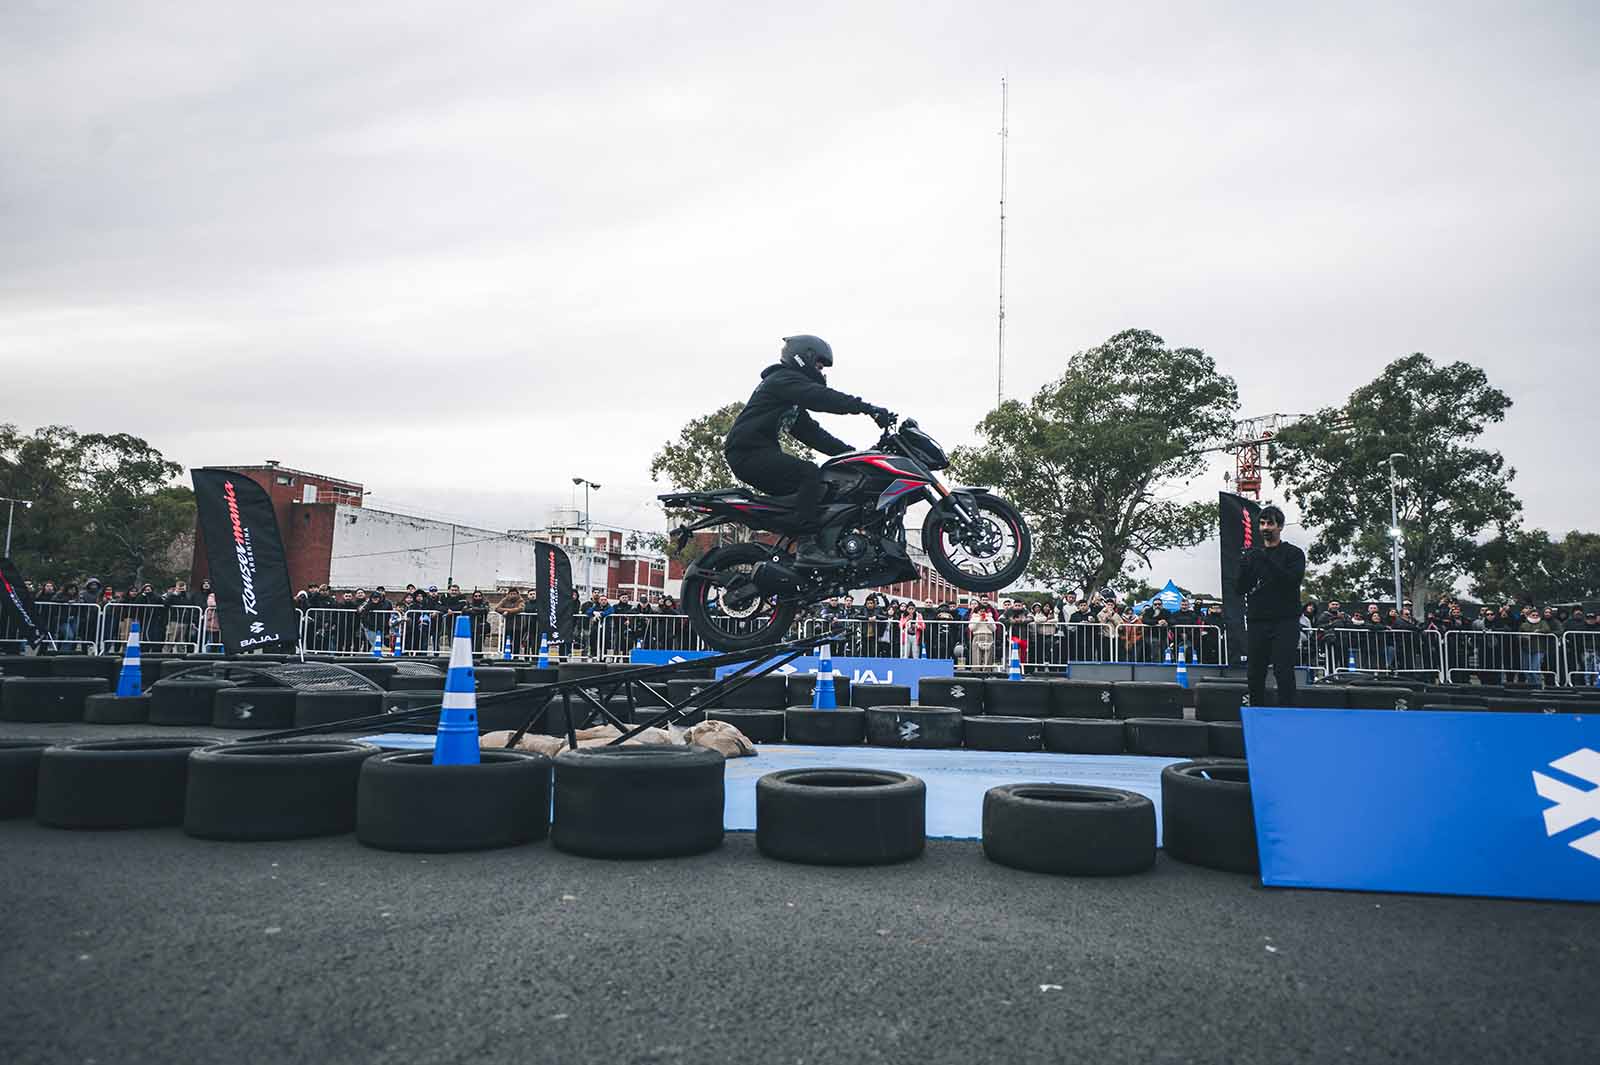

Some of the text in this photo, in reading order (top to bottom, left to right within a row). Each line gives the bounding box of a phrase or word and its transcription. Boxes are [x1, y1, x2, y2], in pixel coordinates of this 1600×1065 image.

[224, 480, 258, 615] Rousermania
[244, 527, 257, 572] ARGENTINA
[240, 633, 280, 648] BAJAJ
